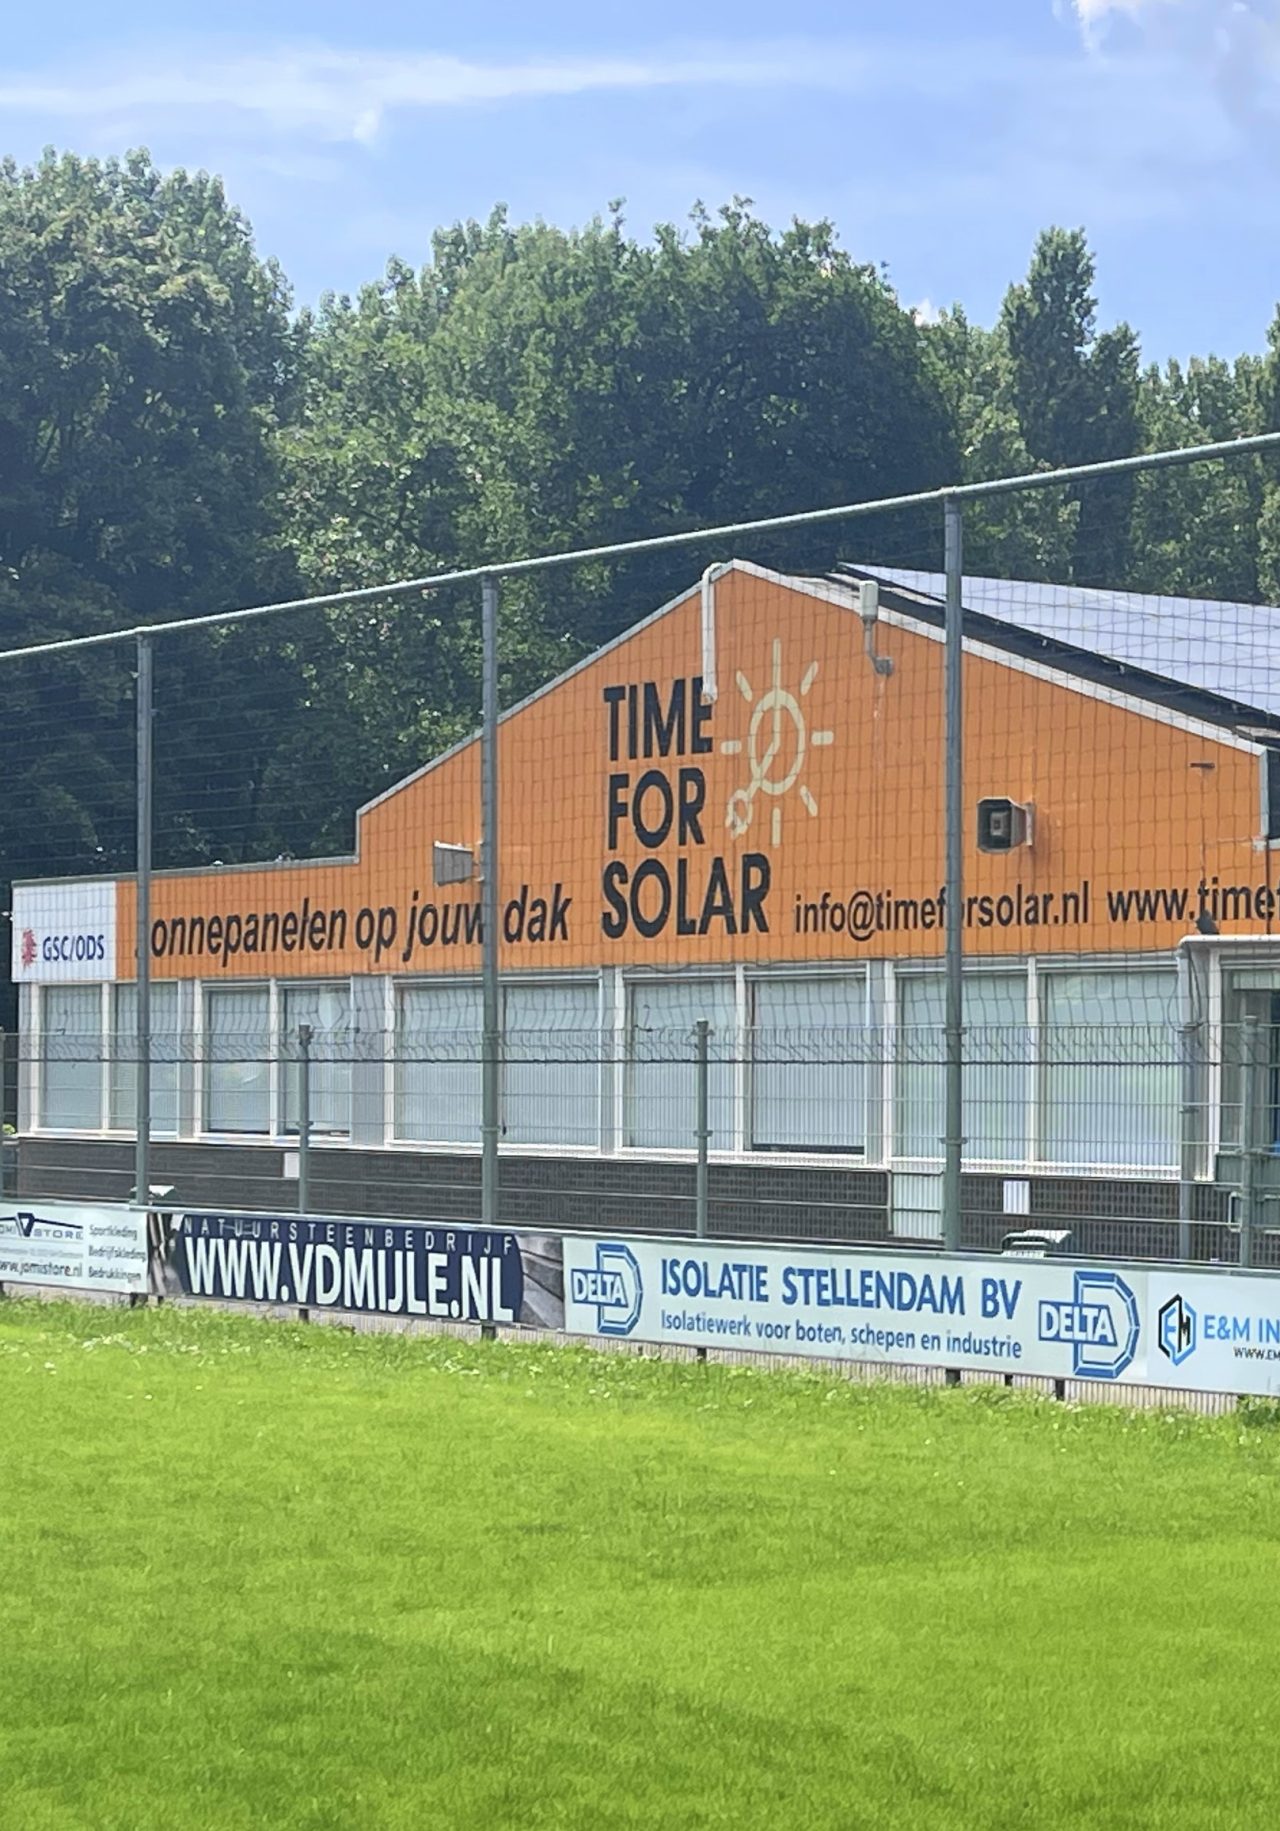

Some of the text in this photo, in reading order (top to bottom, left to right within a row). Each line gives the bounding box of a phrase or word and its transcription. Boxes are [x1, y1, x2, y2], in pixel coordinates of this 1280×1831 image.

[603, 676, 713, 761] TIME
[608, 767, 706, 850] FOR
[134, 897, 347, 968] onnepanelen
[356, 906, 397, 963] op
[503, 883, 572, 943] dak
[602, 853, 771, 938] SOLAR
[795, 880, 1089, 941] info@timefrsolar.nl
[42, 934, 105, 961] GSC/ODS
[184, 1218, 512, 1255] NATUURSTEENBEDRIJF
[185, 1236, 514, 1322] WWW.VDMIJLE.NL
[573, 1271, 626, 1305] DELTA
[661, 1258, 1022, 1320] ISOLATIE STELLENDAM BV
[661, 1310, 1022, 1359] Isolatiewerk voor boten, schepen en industrie
[1040, 1303, 1115, 1344] DELTA
[1204, 1315, 1250, 1341] E&M
